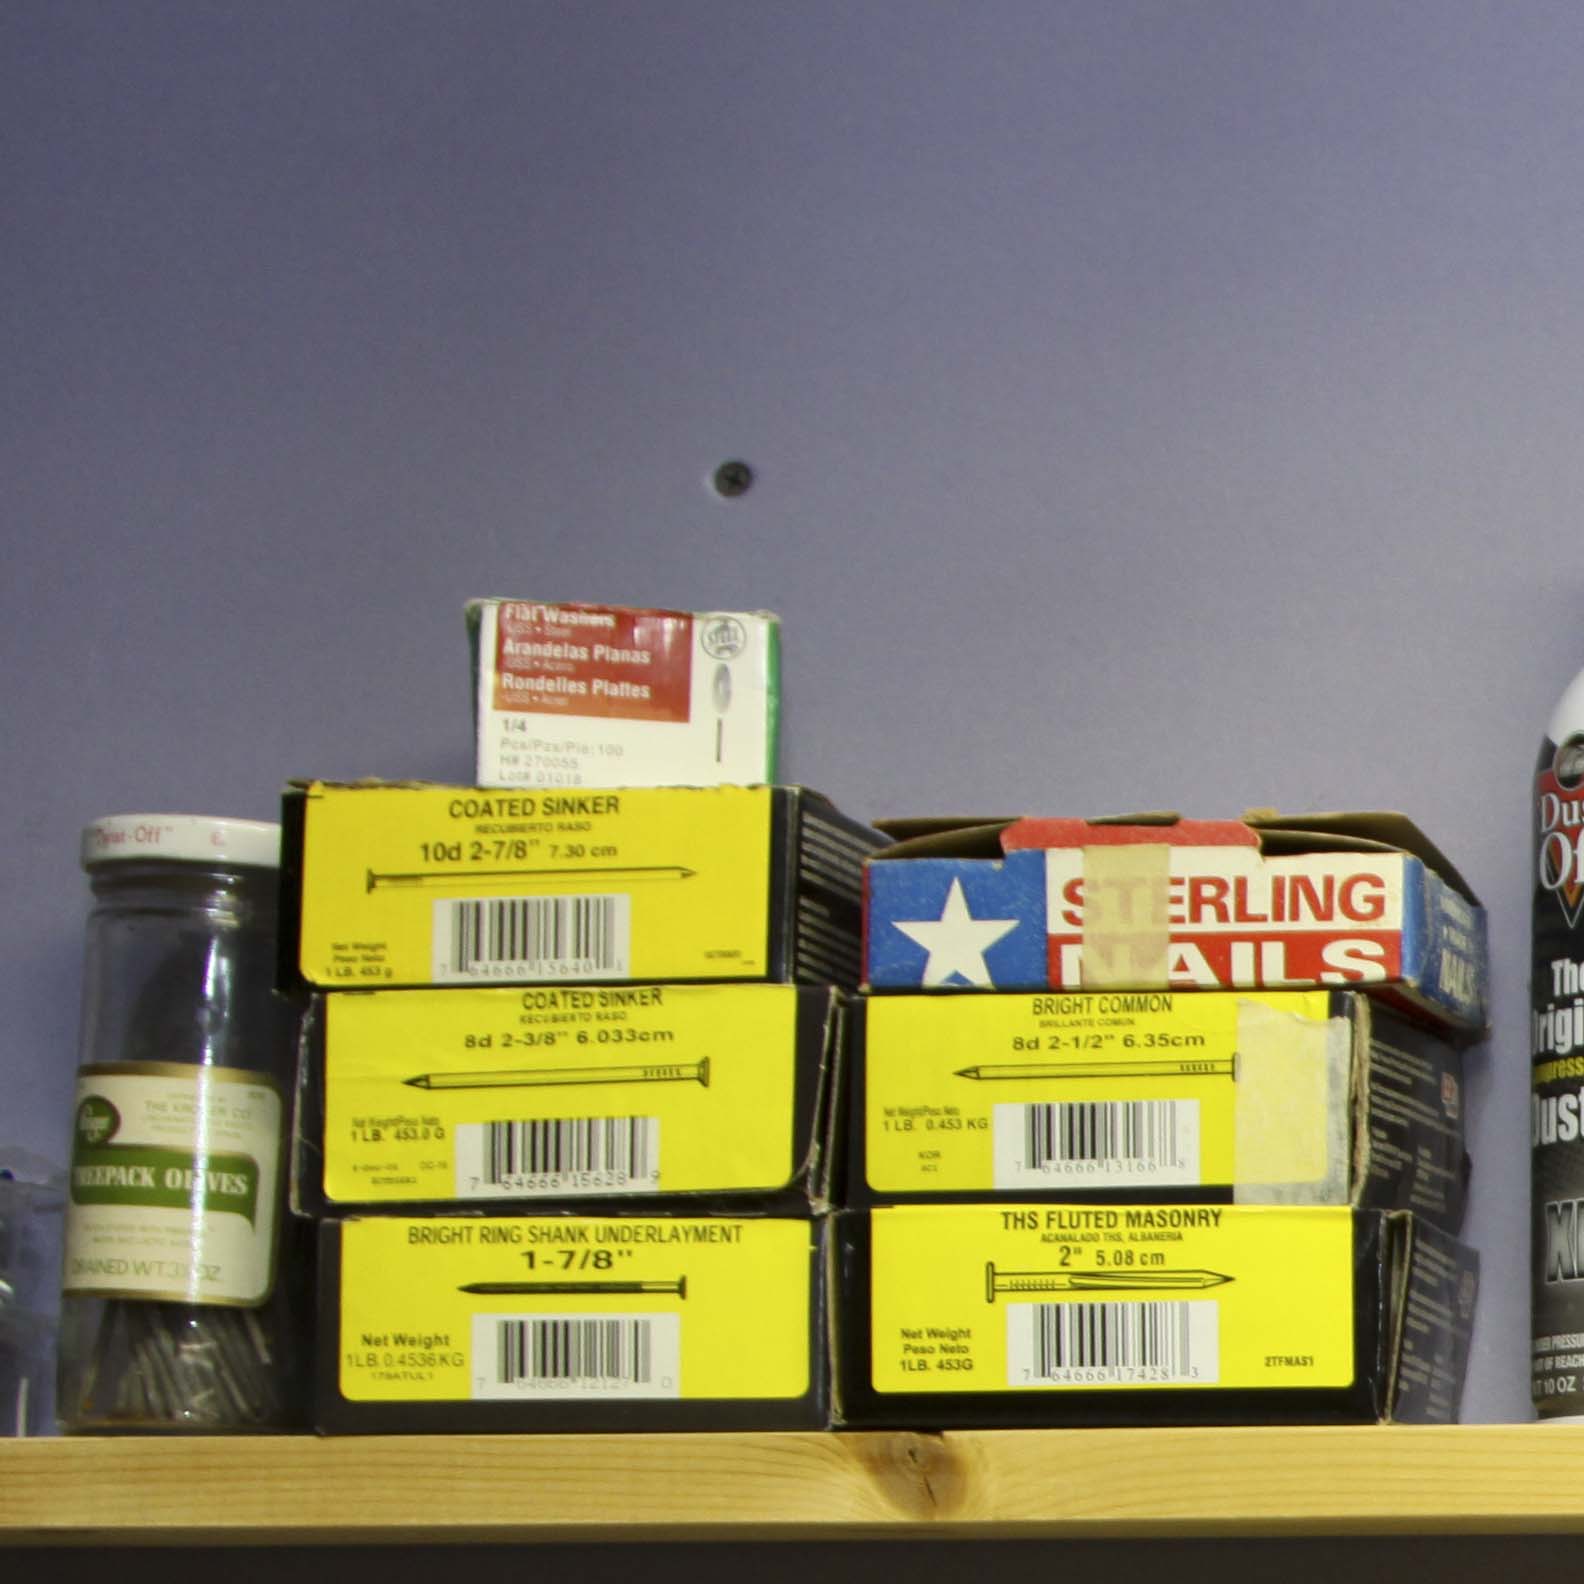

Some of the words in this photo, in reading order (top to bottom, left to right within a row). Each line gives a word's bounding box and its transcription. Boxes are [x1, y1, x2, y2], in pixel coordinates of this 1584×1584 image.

[503, 639, 588, 659] Arandelas
[594, 646, 651, 665] Planas
[503, 673, 586, 695] Rondelles
[592, 679, 650, 699] Plattes
[502, 718, 526, 733] 1/4
[449, 798, 536, 818] COATED
[542, 796, 620, 816] SINKER
[421, 841, 462, 863] 10d
[469, 837, 540, 860] 2-7/8"
[550, 843, 585, 859] 7.30
[591, 842, 618, 858] cm
[1060, 872, 1387, 929] STERLING
[1060, 938, 1386, 989] NAILS
[522, 991, 594, 1010] COATED
[597, 988, 664, 1008] SINKER
[1032, 995, 1094, 1015] BRIGHT
[1099, 994, 1173, 1014] COMMON
[465, 1030, 492, 1049] 8d
[501, 1030, 568, 1048] 2-3/8"
[1012, 1034, 1041, 1051] 8d
[1048, 1033, 1115, 1050] 2-1/2"
[1001, 1211, 1040, 1231] THS
[1045, 1210, 1118, 1230] FLUTED
[1125, 1209, 1223, 1228] MASONRY
[408, 1225, 474, 1245] BRIGHT
[480, 1225, 521, 1245] RING
[528, 1225, 589, 1244] SHANK
[595, 1224, 743, 1244] UNDERLAYMENT
[520, 1248, 634, 1271] 1-7/8"
[1058, 1245, 1083, 1267] 2"
[1095, 1248, 1135, 1267] 5.08
[1140, 1250, 1165, 1266] cm
[361, 1333, 387, 1348] Net
[392, 1333, 450, 1350] Weight
[900, 1329, 923, 1340] Net
[926, 1327, 972, 1344] Weight
[903, 1343, 934, 1356] Peso
[937, 1342, 970, 1355] Neto
[1557, 1376, 1576, 1393] OZ
